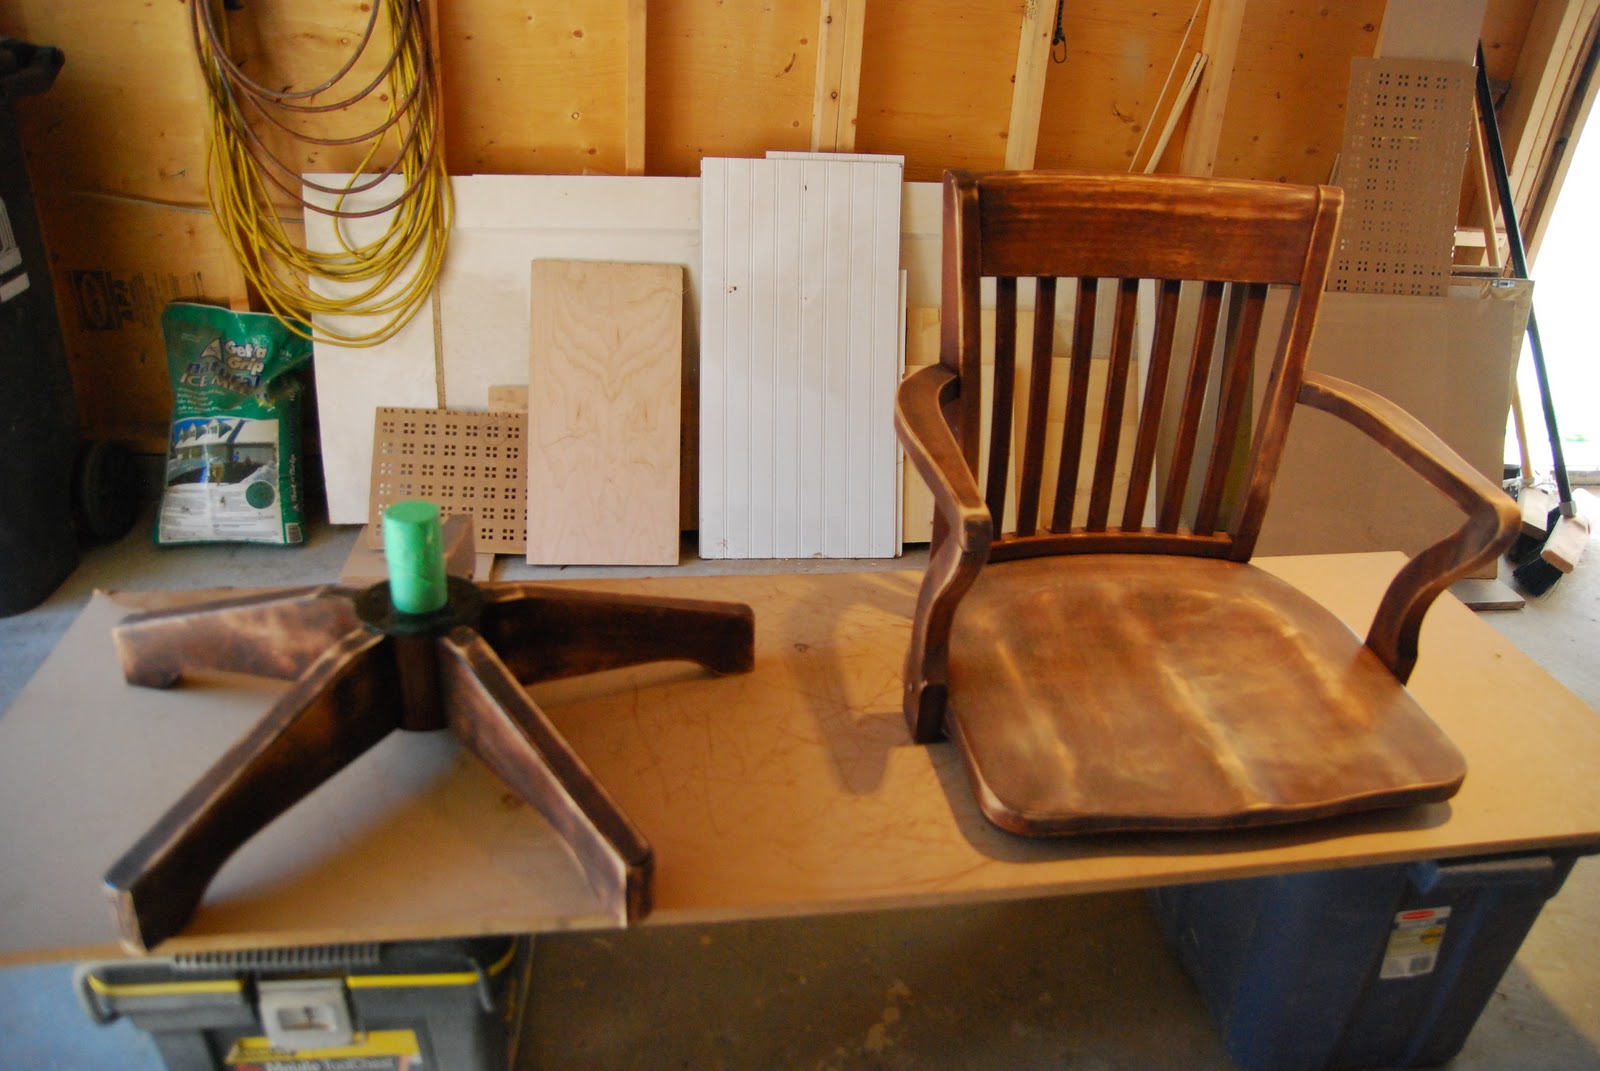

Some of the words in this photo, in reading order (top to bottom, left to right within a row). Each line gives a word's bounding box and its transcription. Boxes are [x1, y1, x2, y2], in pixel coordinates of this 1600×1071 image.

[225, 340, 253, 358] Get
[254, 346, 268, 359] a
[226, 356, 265, 376] Grip
[180, 372, 208, 387] ICE
